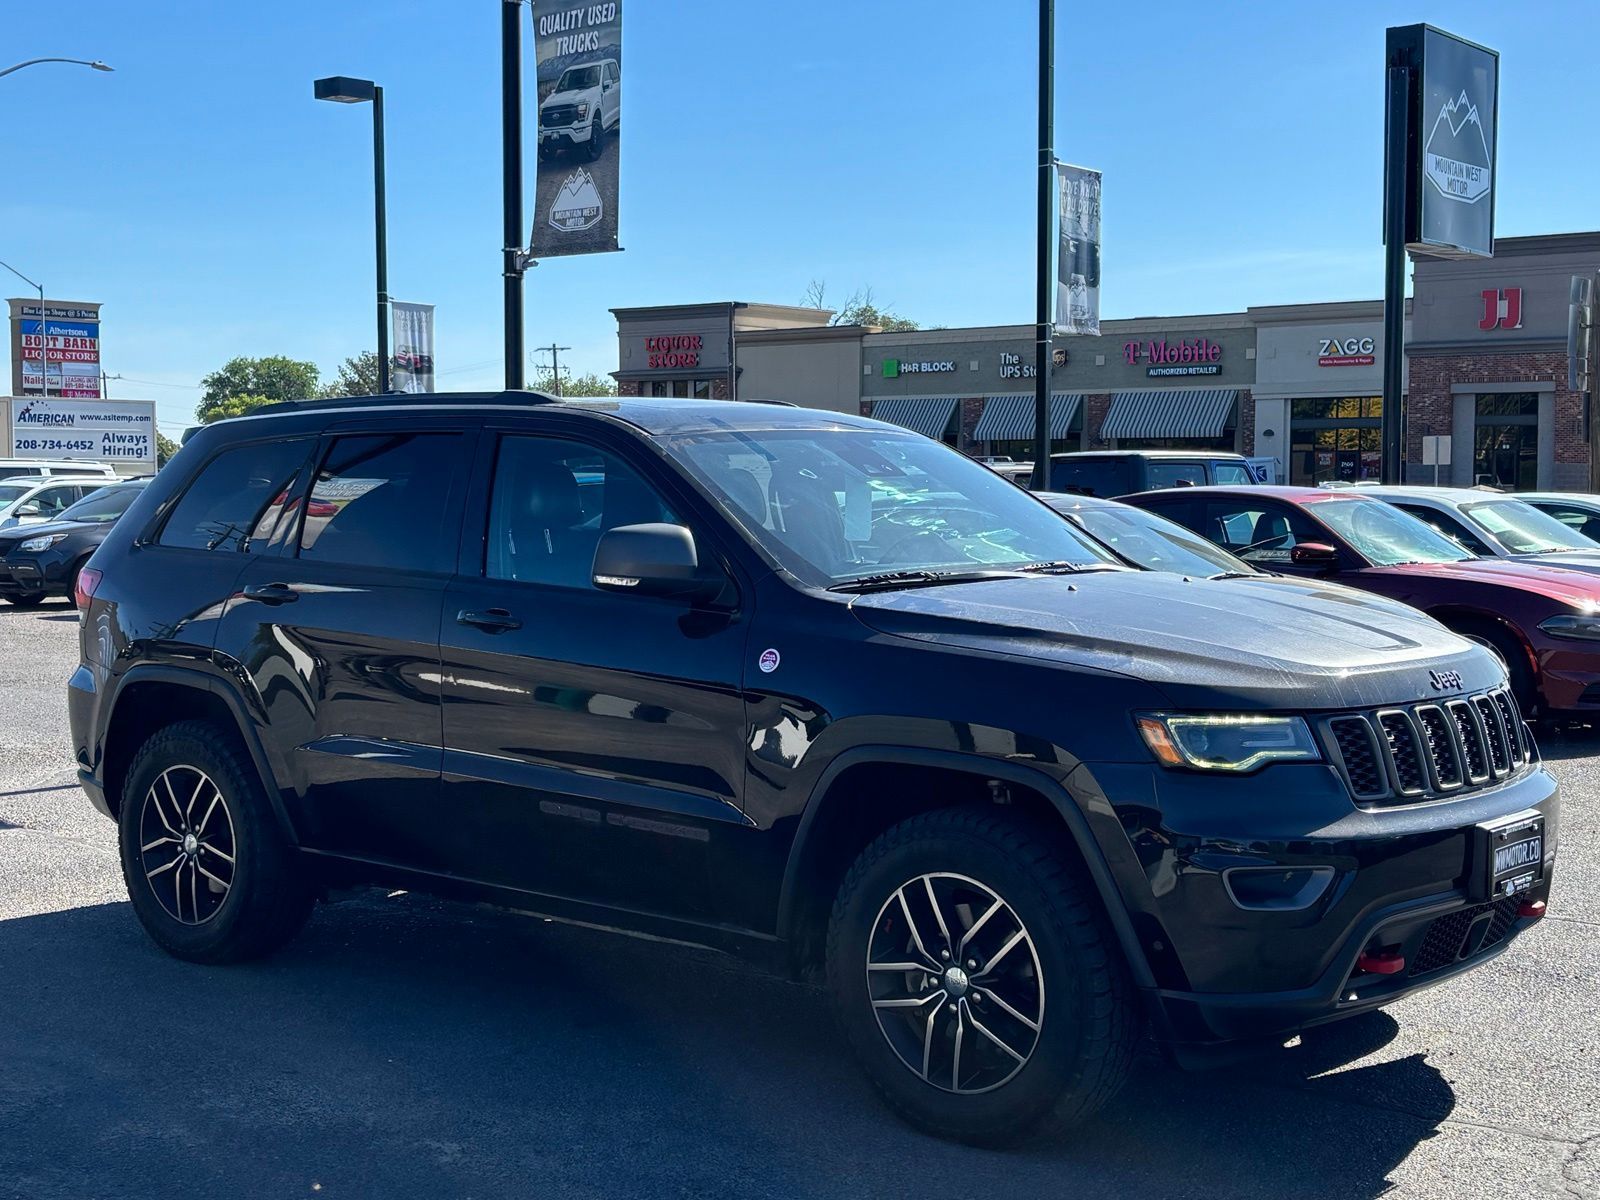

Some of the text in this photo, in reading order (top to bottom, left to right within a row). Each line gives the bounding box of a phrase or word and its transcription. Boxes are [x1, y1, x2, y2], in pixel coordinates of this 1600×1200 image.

[540, 2, 616, 36] QUALITY USED
[556, 31, 599, 56] TRUCKS
[1435, 156, 1481, 182] MOUNTAIN WEST
[1447, 177, 1468, 196] MOTOR
[36, 307, 50, 315] Laes
[49, 326, 88, 336] Albertsons
[63, 337, 97, 349] BARN
[645, 336, 701, 352] LIQUOR
[1319, 337, 1374, 355] ZAGG
[24, 350, 97, 360] LIQOR STORE
[649, 353, 697, 368] STORE
[1000, 353, 1019, 364] The
[901, 361, 955, 373] H&R BLOCK
[1000, 366, 1020, 378] UPS
[1149, 366, 1217, 376] AUTHORIZED RETAILER
[17, 411, 75, 424] AMERICAN
[79, 413, 151, 423] www.asitemp.com
[16, 439, 94, 450] 208-734-6452
[102, 433, 148, 444] Always
[103, 445, 148, 458] Hiring!
[1429, 670, 1463, 691] Jeep
[1496, 839, 1540, 873] MWMOTOR.CO
